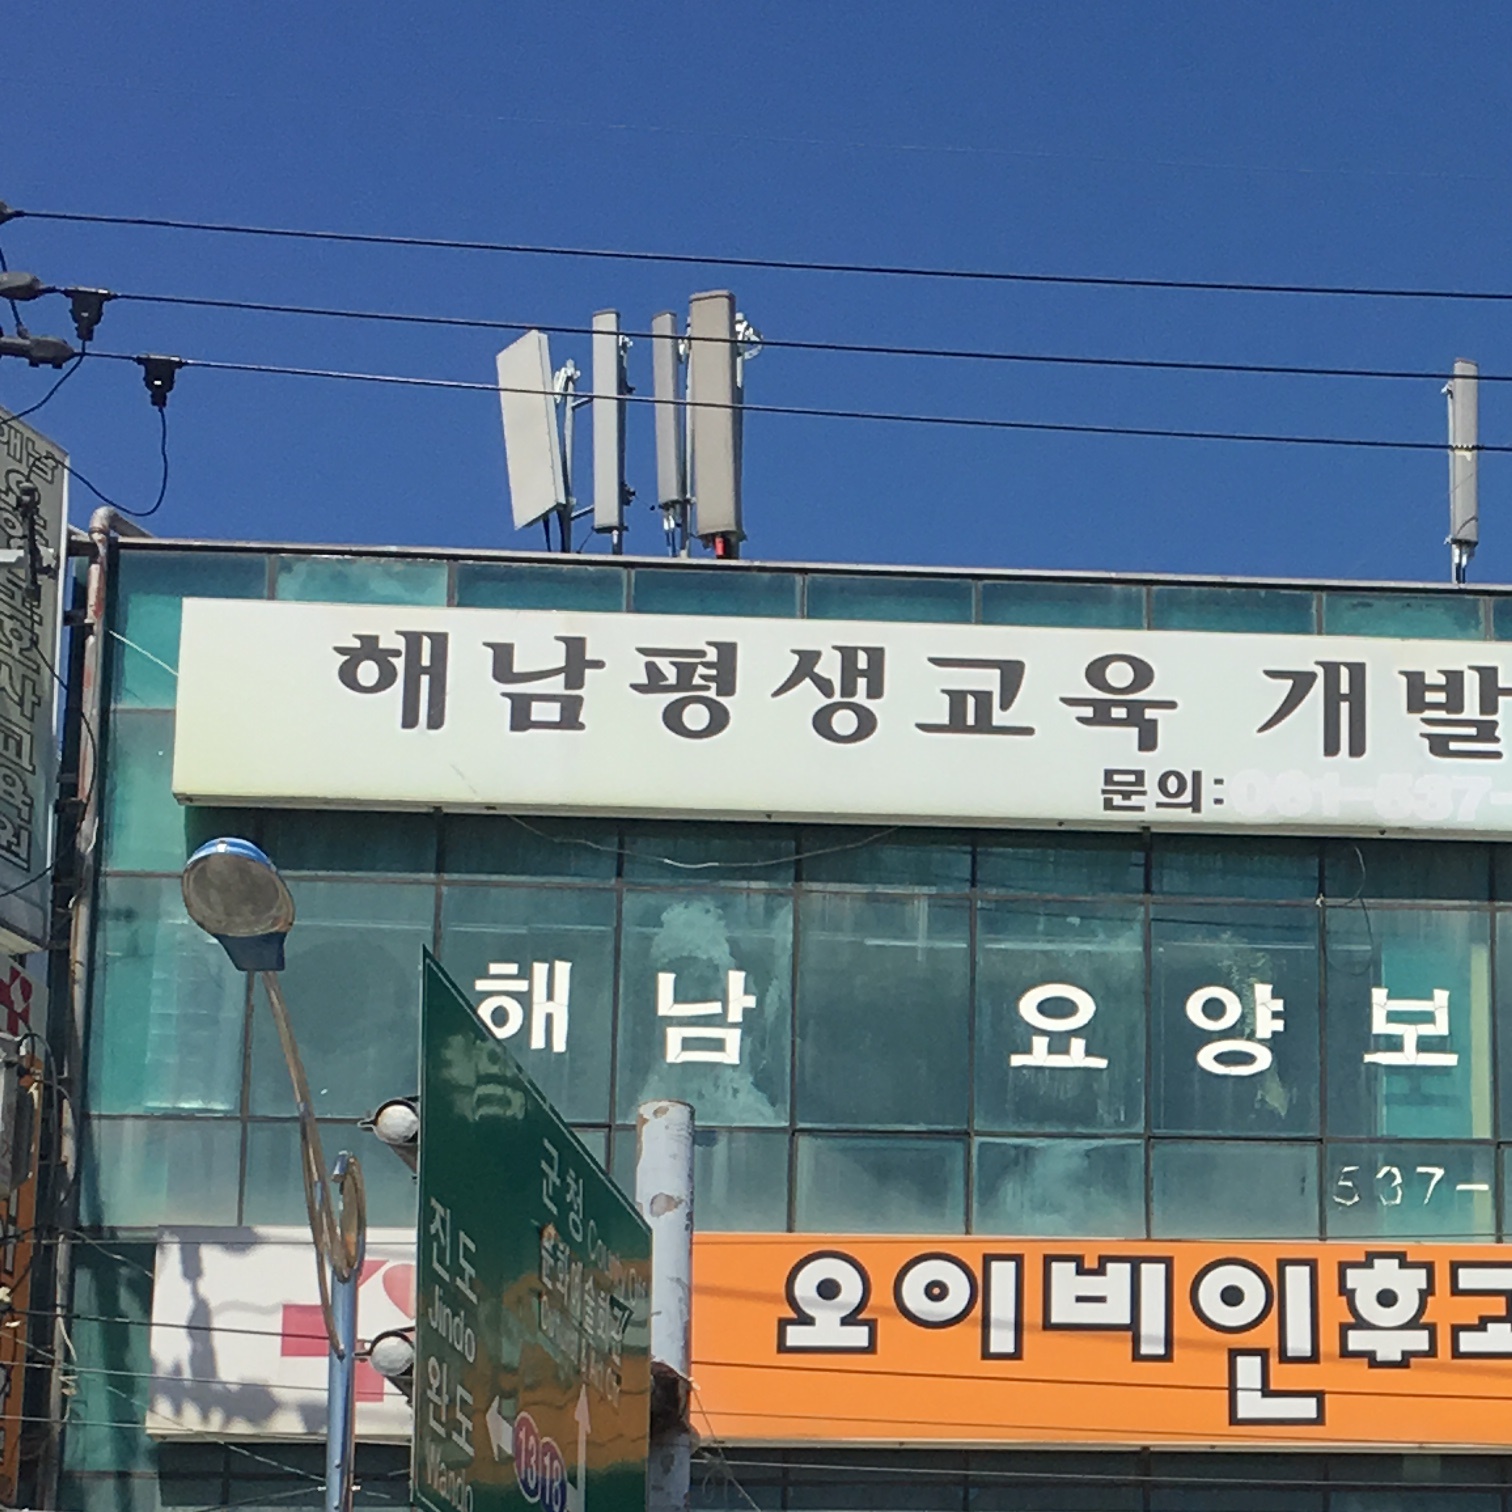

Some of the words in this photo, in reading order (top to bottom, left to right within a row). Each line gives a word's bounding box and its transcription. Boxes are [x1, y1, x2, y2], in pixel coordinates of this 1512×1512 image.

[333, 629, 1179, 753] 해남평생교육
[430, 1197, 479, 1305] 진도
[428, 1284, 476, 1364] Jindo
[427, 1356, 474, 1458] 완도
[518, 1426, 538, 1491] 13
